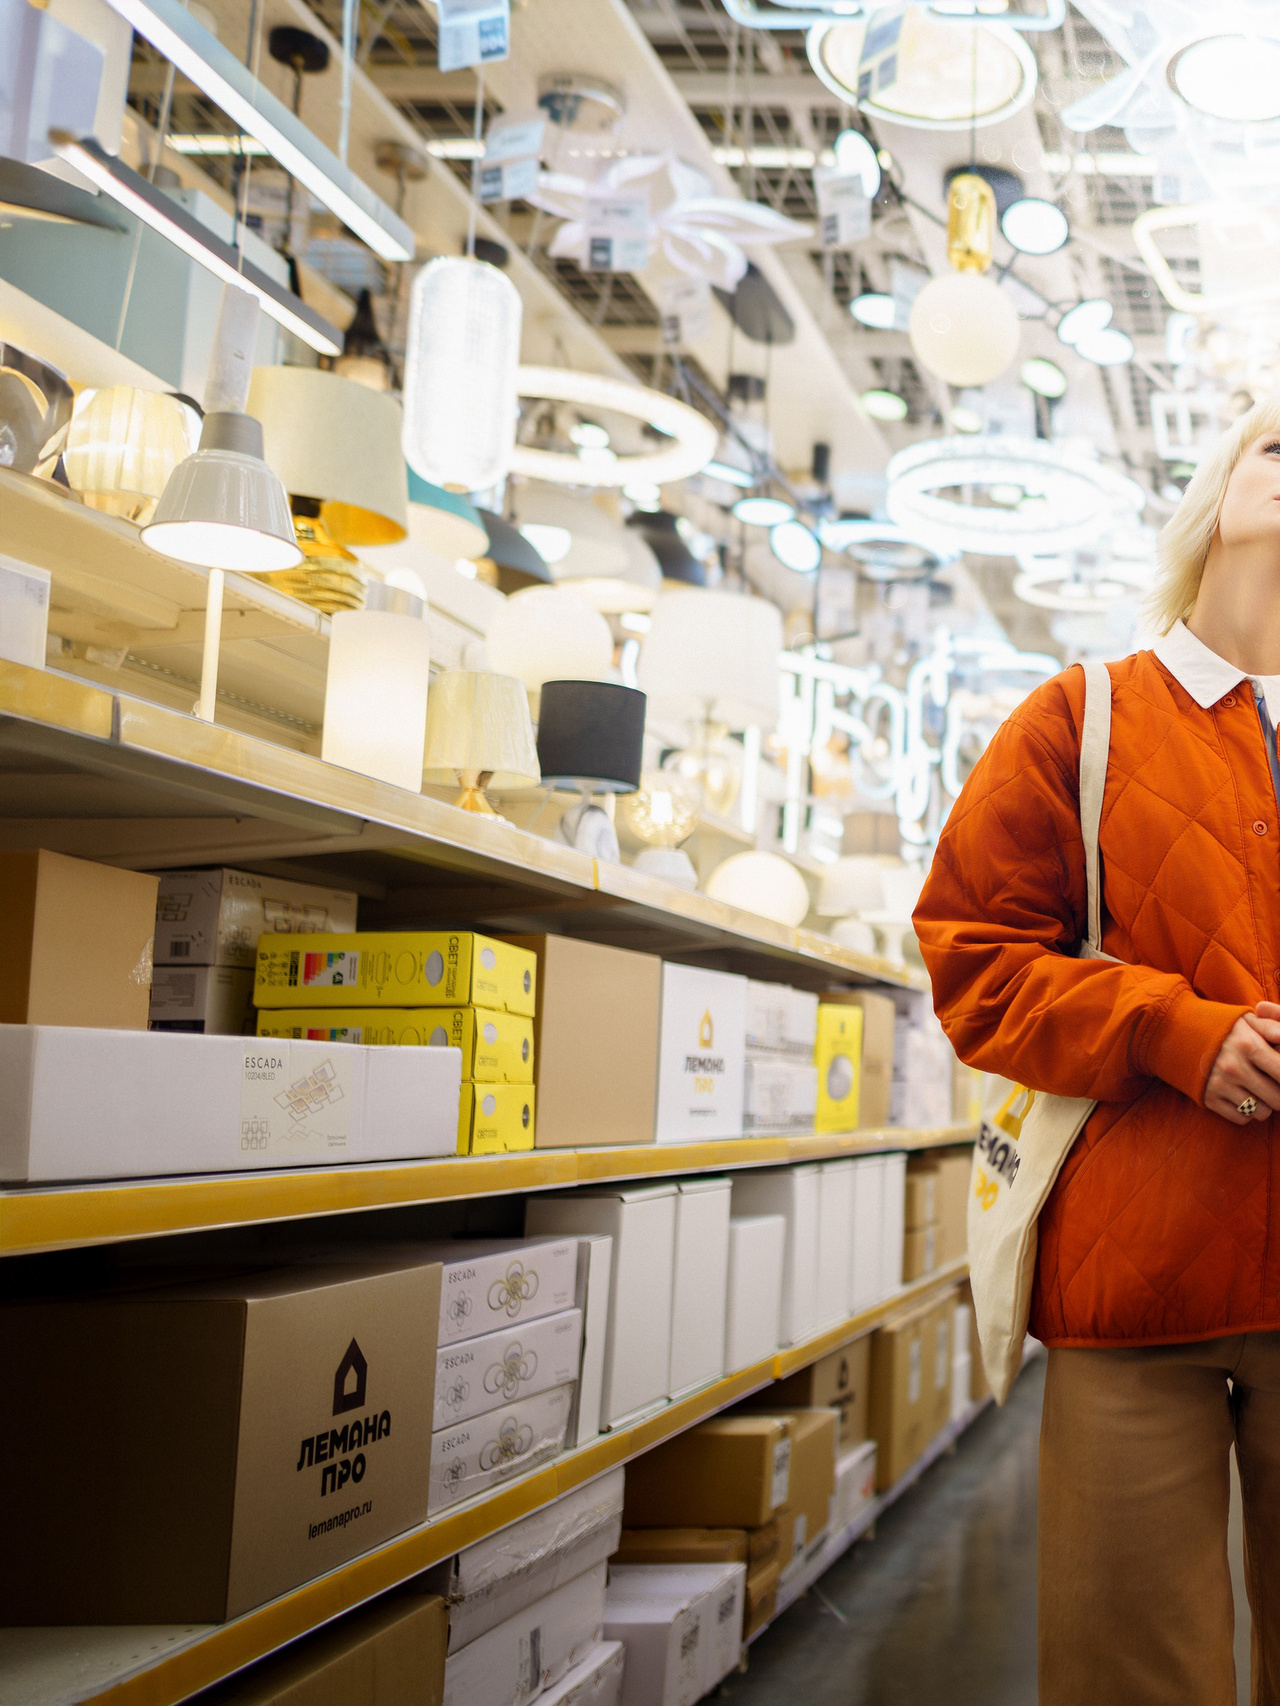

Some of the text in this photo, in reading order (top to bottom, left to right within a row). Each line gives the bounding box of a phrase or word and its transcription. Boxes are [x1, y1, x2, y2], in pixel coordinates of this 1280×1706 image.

[229, 875, 262, 889] ESCADA
[245, 1057, 283, 1069] ESCADA
[448, 1268, 476, 1284] ESCADA
[445, 1352, 475, 1370] ESCADA
[297, 1410, 391, 1472] ЛЕМАНА
[321, 1453, 366, 1497] ПРО
[308, 1500, 372, 1540] lemanapro.ru
